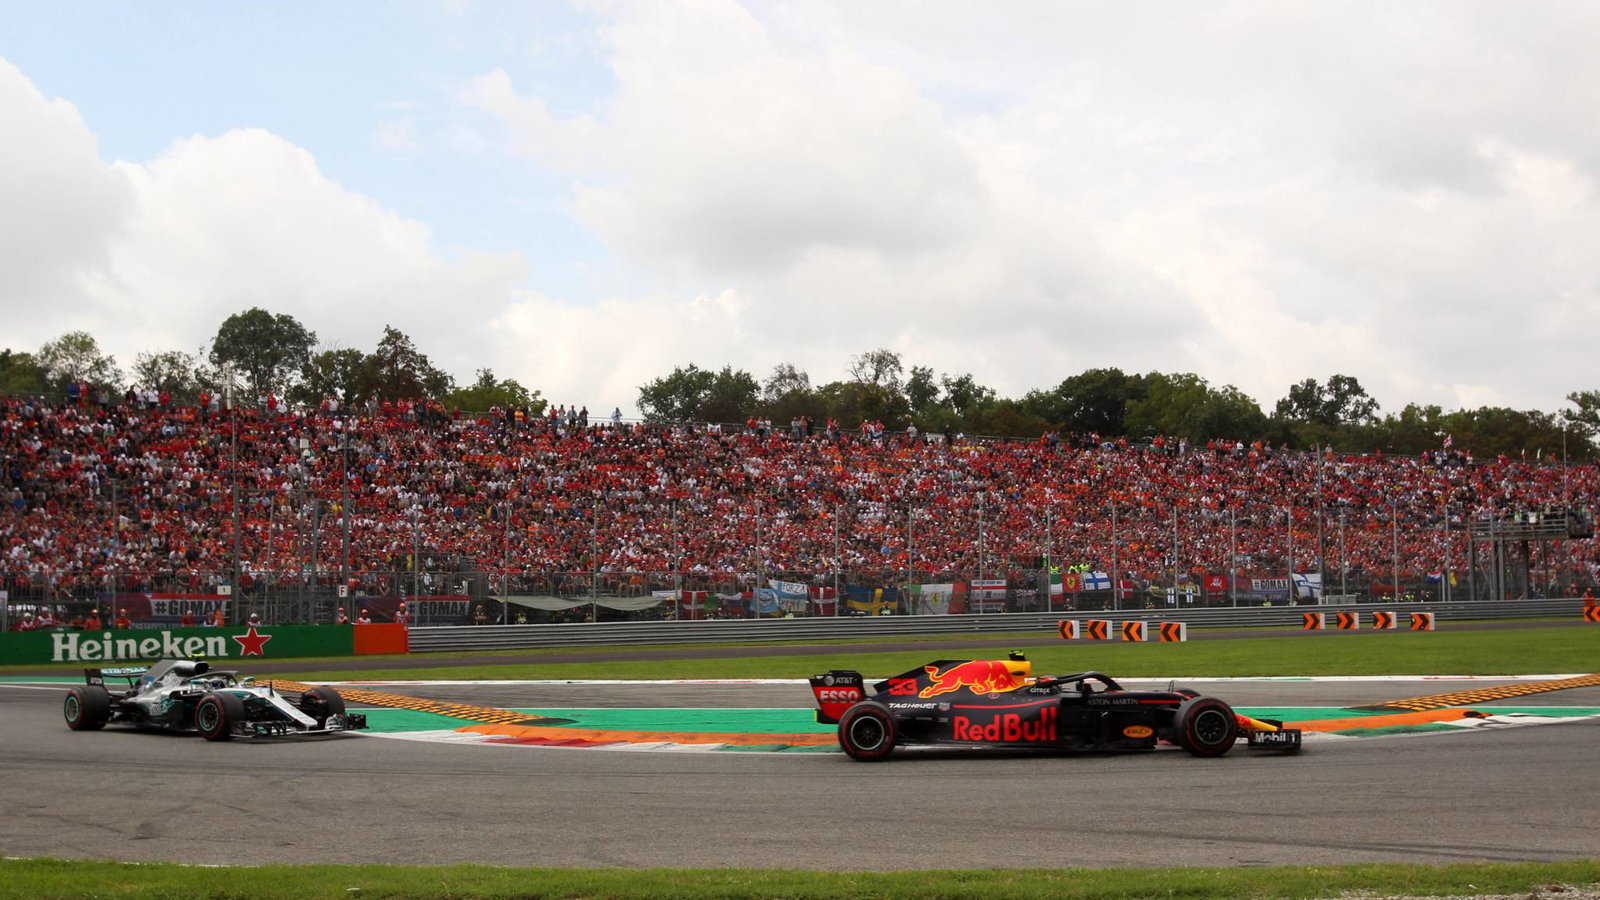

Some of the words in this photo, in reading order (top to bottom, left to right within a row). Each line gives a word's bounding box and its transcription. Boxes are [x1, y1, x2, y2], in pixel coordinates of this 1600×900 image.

[339, 586, 345, 594] F
[783, 583, 805, 593] FORZA
[1253, 579, 1287, 590] #GOMAX
[154, 600, 223, 615] #GOMAX
[51, 631, 229, 661] Heineken
[888, 678, 918, 695] 33
[820, 690, 858, 704] ESSO
[953, 713, 1000, 741] Red
[1003, 706, 1056, 742] Bull
[1255, 732, 1286, 743] Mobil
